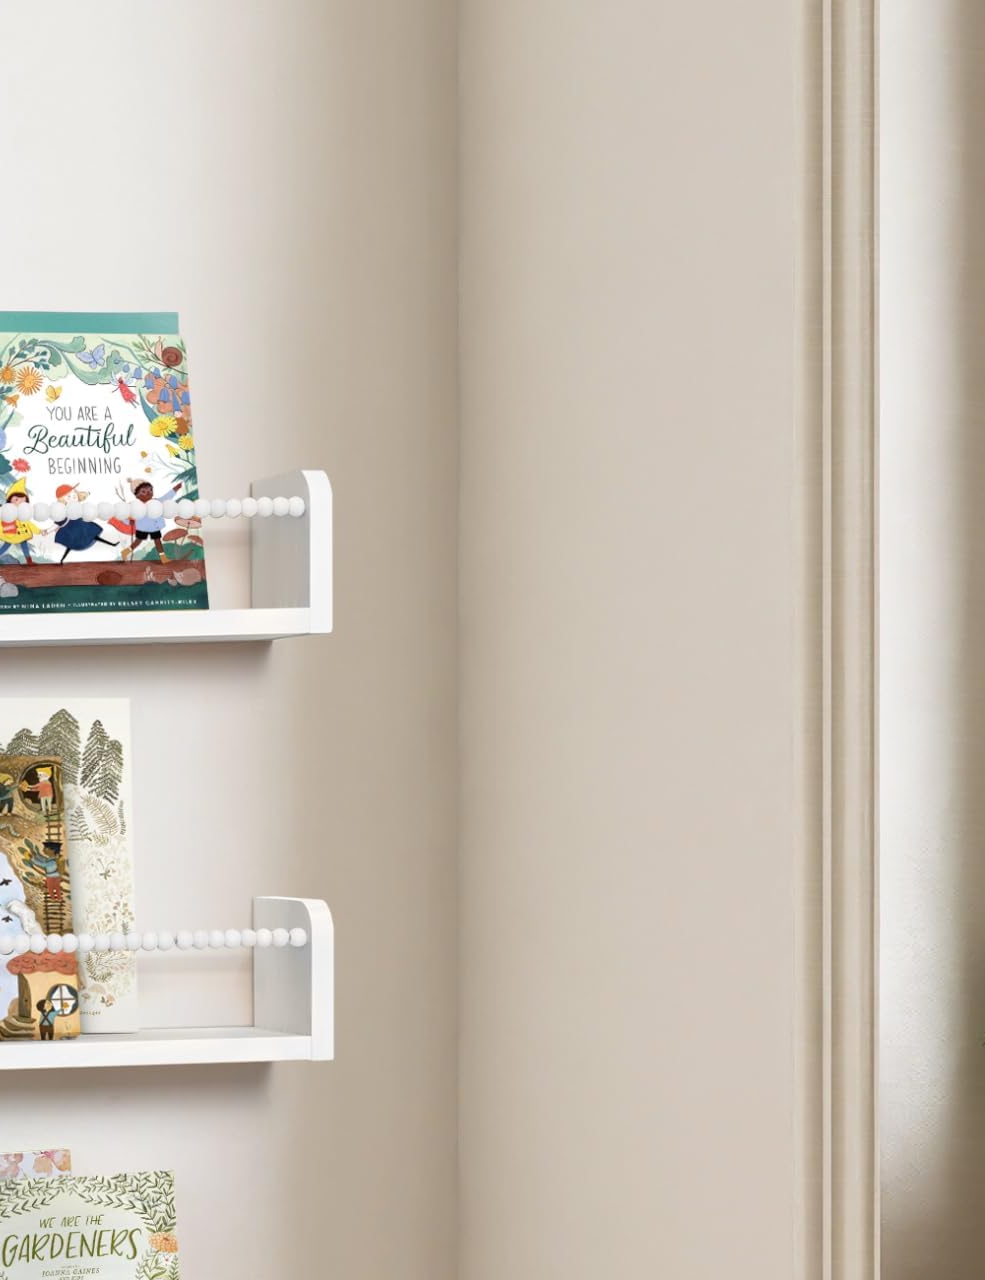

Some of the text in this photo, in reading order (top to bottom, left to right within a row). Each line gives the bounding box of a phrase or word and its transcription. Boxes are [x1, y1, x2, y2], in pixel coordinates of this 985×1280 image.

[46, 406, 112, 421] YOU ARE A
[23, 422, 136, 455] Beautiful
[48, 457, 121, 475] BEGINNING
[39, 1214, 104, 1229] WE ARE THE
[2, 1228, 142, 1268] GARDENERS
